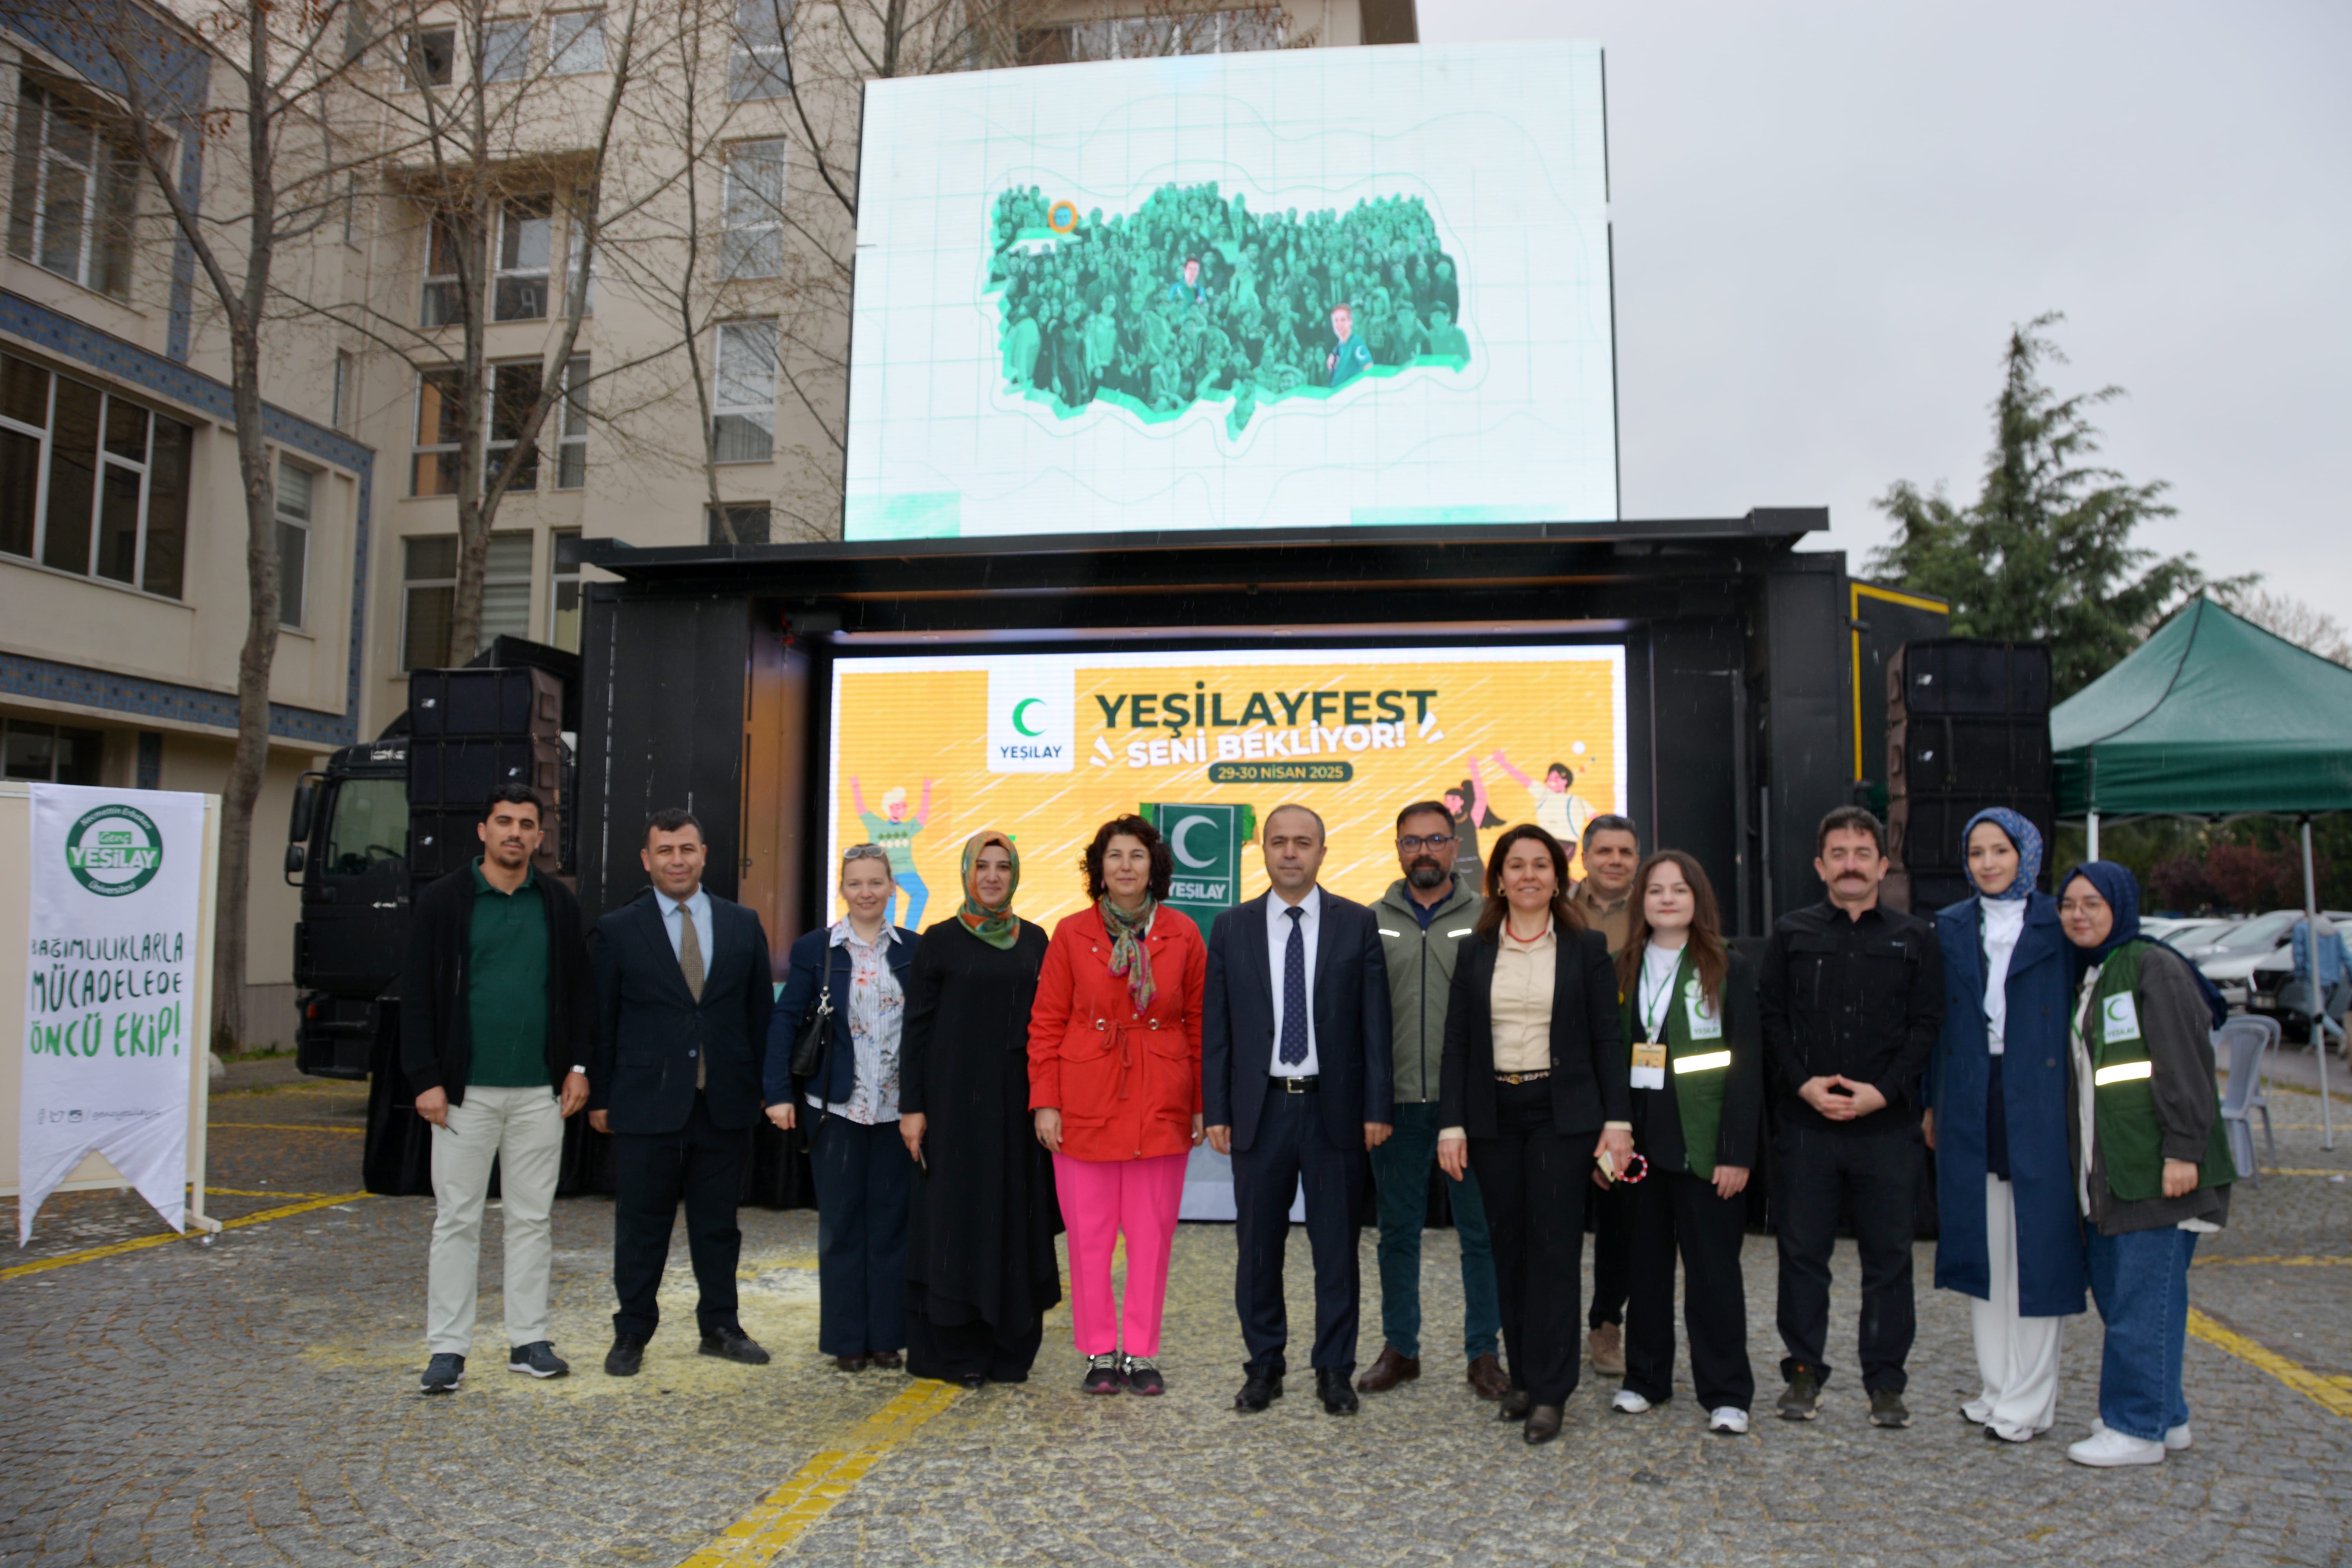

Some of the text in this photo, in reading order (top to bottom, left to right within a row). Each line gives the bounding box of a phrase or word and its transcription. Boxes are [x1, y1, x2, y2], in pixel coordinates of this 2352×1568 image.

[1095, 681, 1437, 739] YEŞİLAYFEST
[1000, 746, 1062, 762] YEŞİLAY
[1127, 720, 1406, 768] SENİ BEKLİYOR!
[1218, 764, 1344, 780] 29-30 NİSAN 2025
[80, 807, 152, 830] Necmettin Erbakan
[99, 832, 130, 844] Genç
[31, 931, 183, 963] BAĞIMLILIKLARLA
[31, 963, 182, 1014] MÜCADELEDE
[30, 1000, 180, 1057] ÖNCÜ EKİP!
